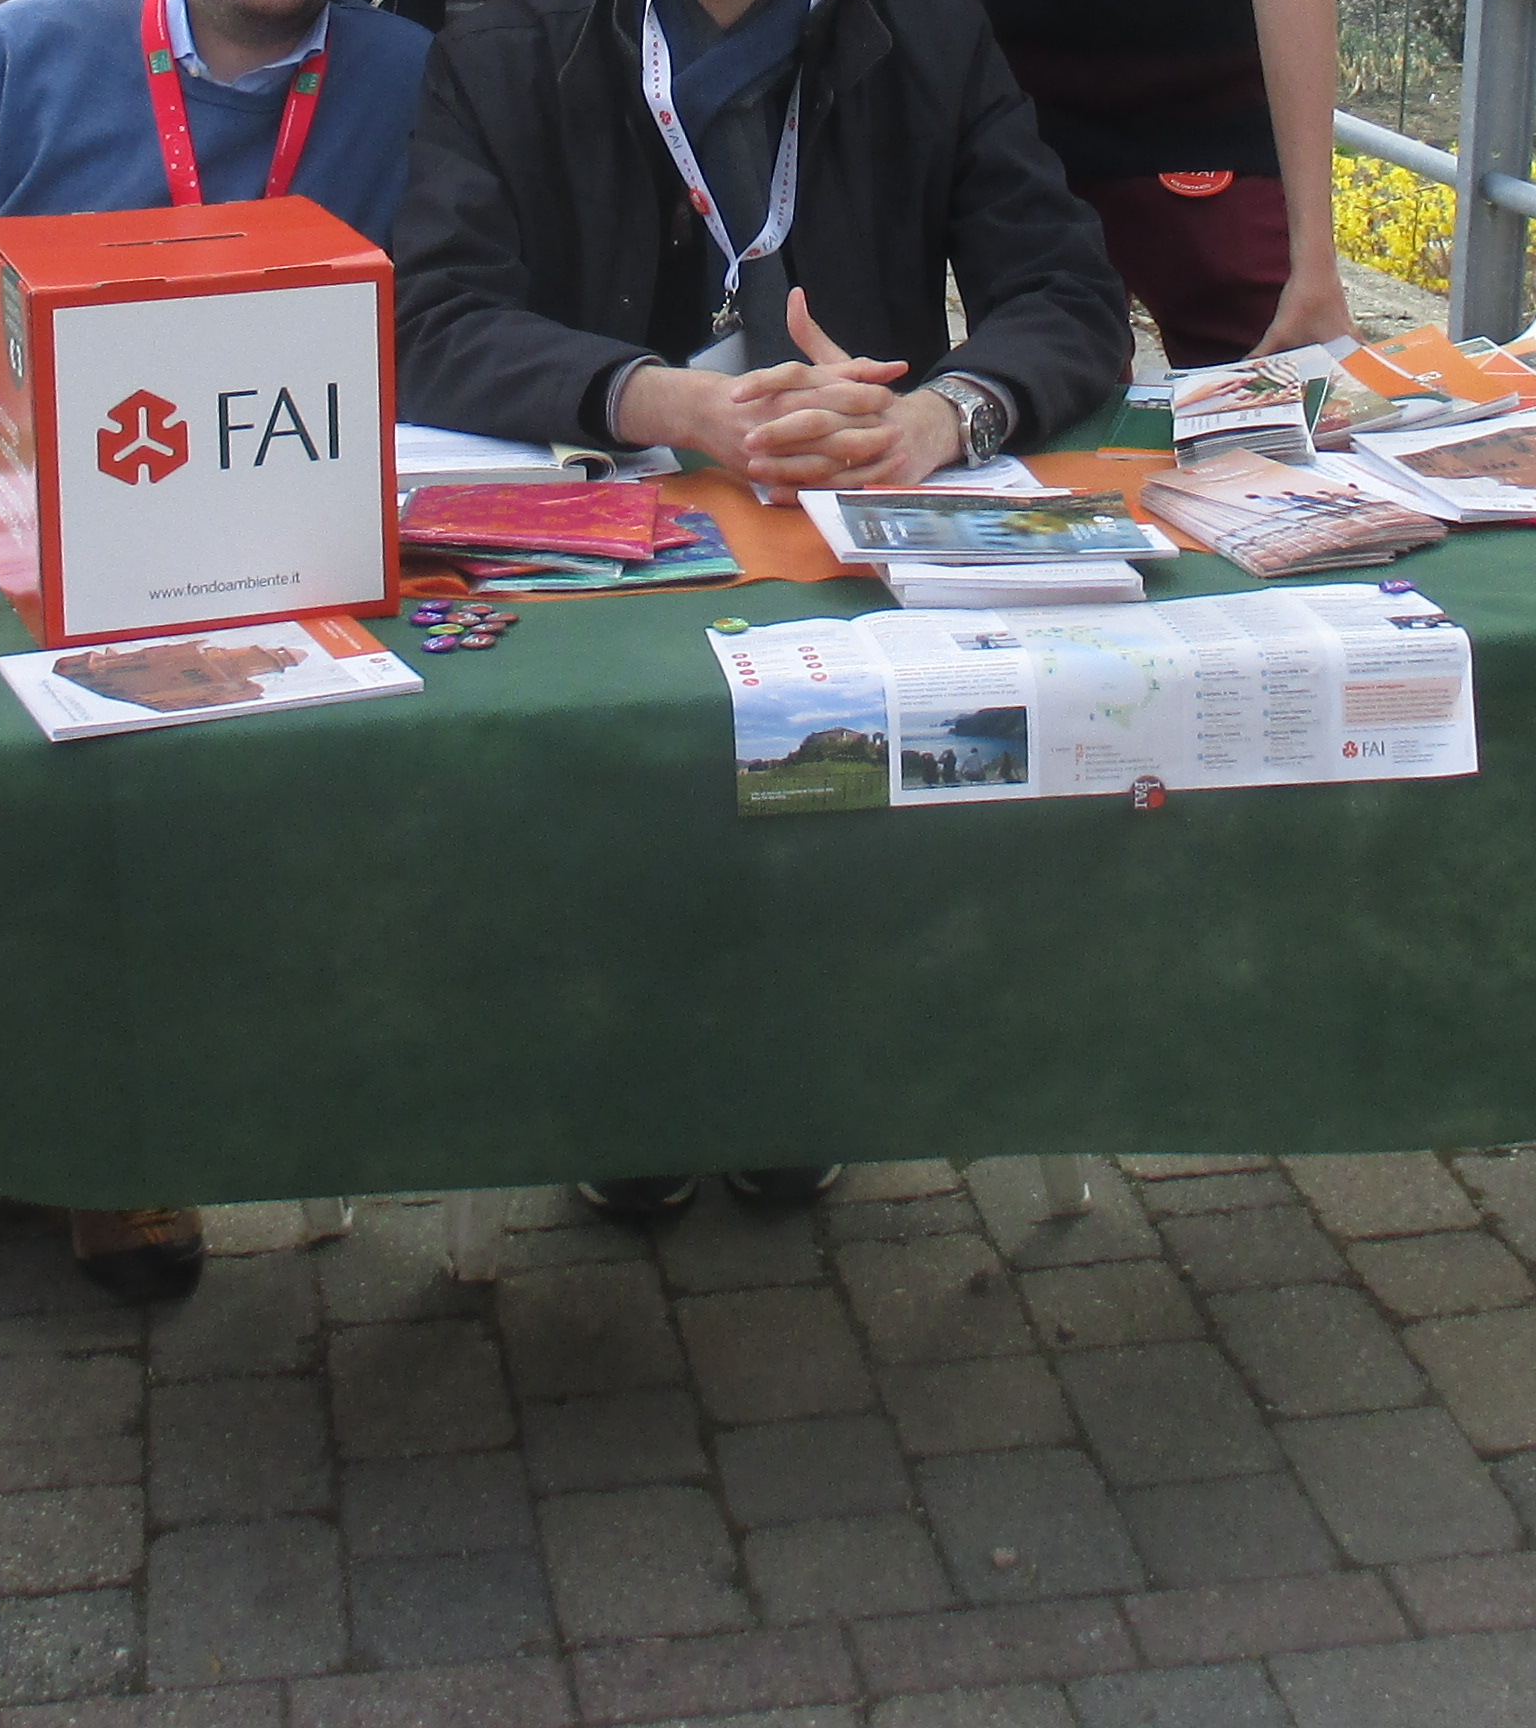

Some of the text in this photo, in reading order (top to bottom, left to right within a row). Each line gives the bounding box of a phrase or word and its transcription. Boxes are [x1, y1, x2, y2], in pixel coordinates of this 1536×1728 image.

[217, 382, 341, 470] FAI
[149, 571, 301, 600] www.fondoambiente.it
[1362, 740, 1385, 757] FAI
